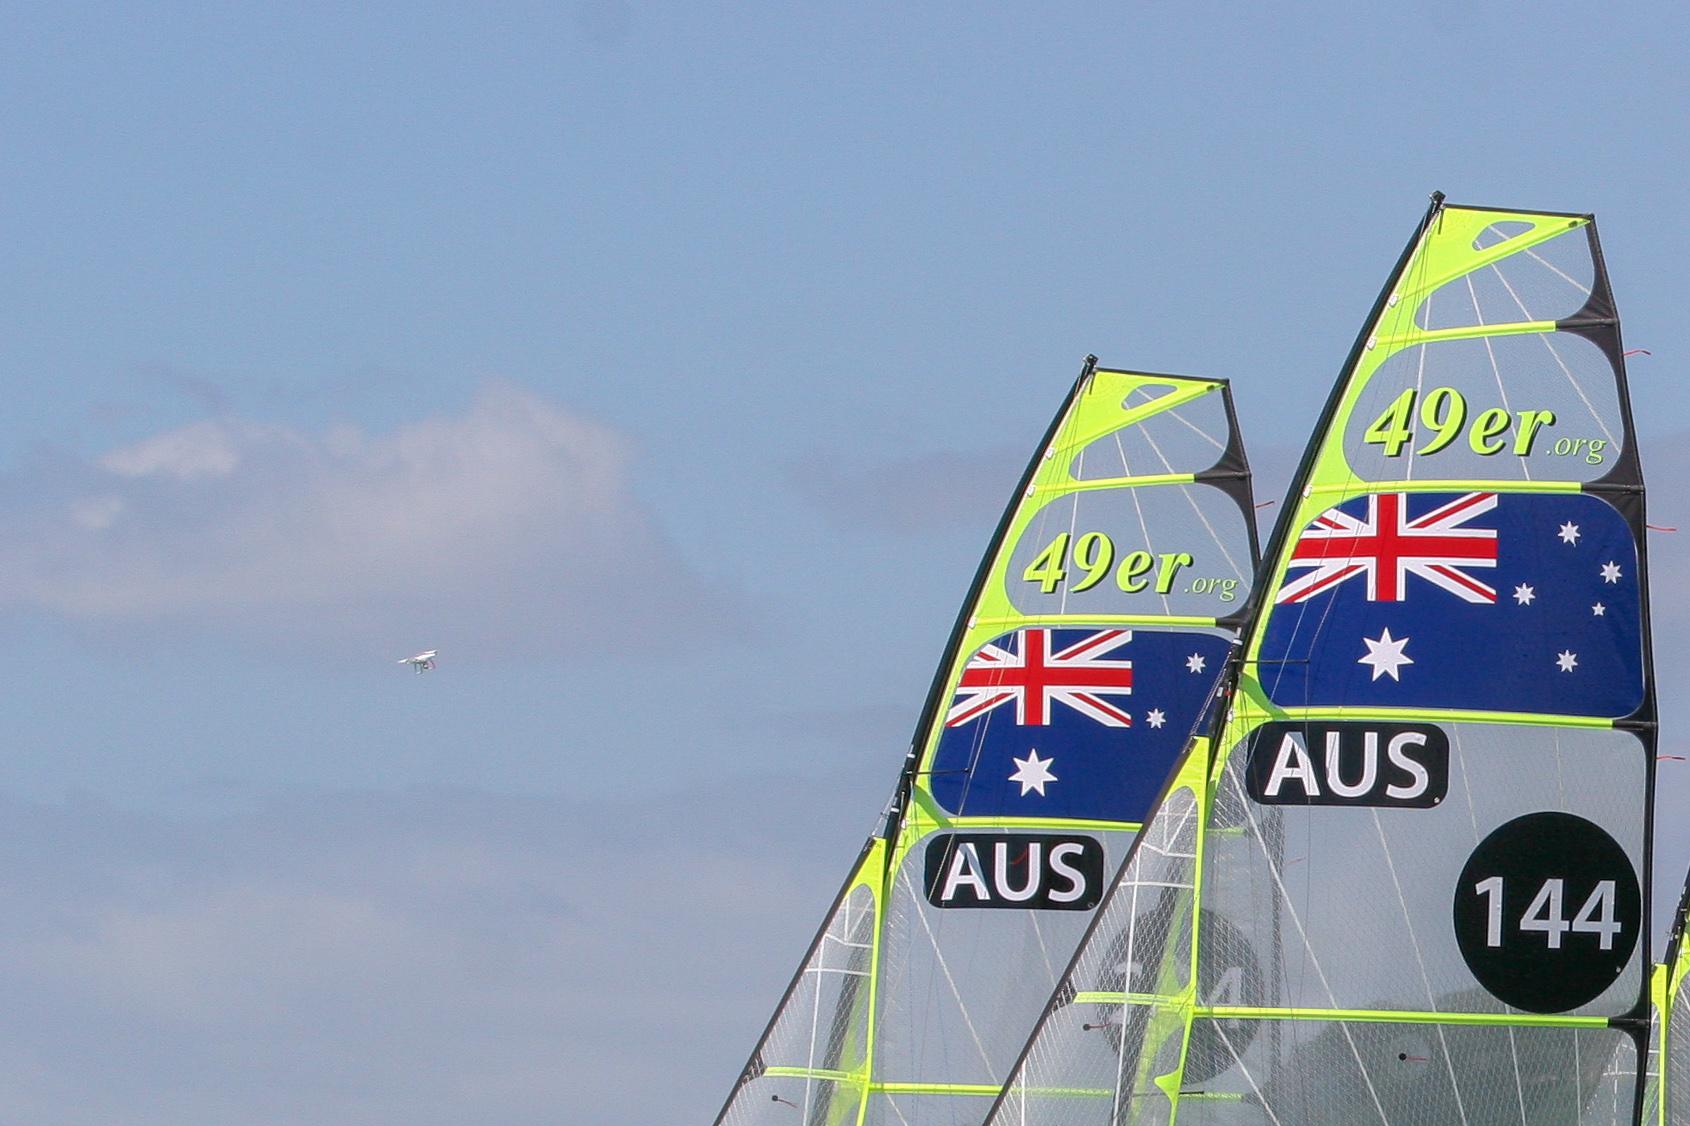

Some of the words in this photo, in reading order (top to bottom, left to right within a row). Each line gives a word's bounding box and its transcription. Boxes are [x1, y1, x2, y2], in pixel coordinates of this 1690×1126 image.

[1264, 731, 1430, 799] AUS
[941, 841, 1087, 903] AUS
[1474, 876, 1622, 951] 144
